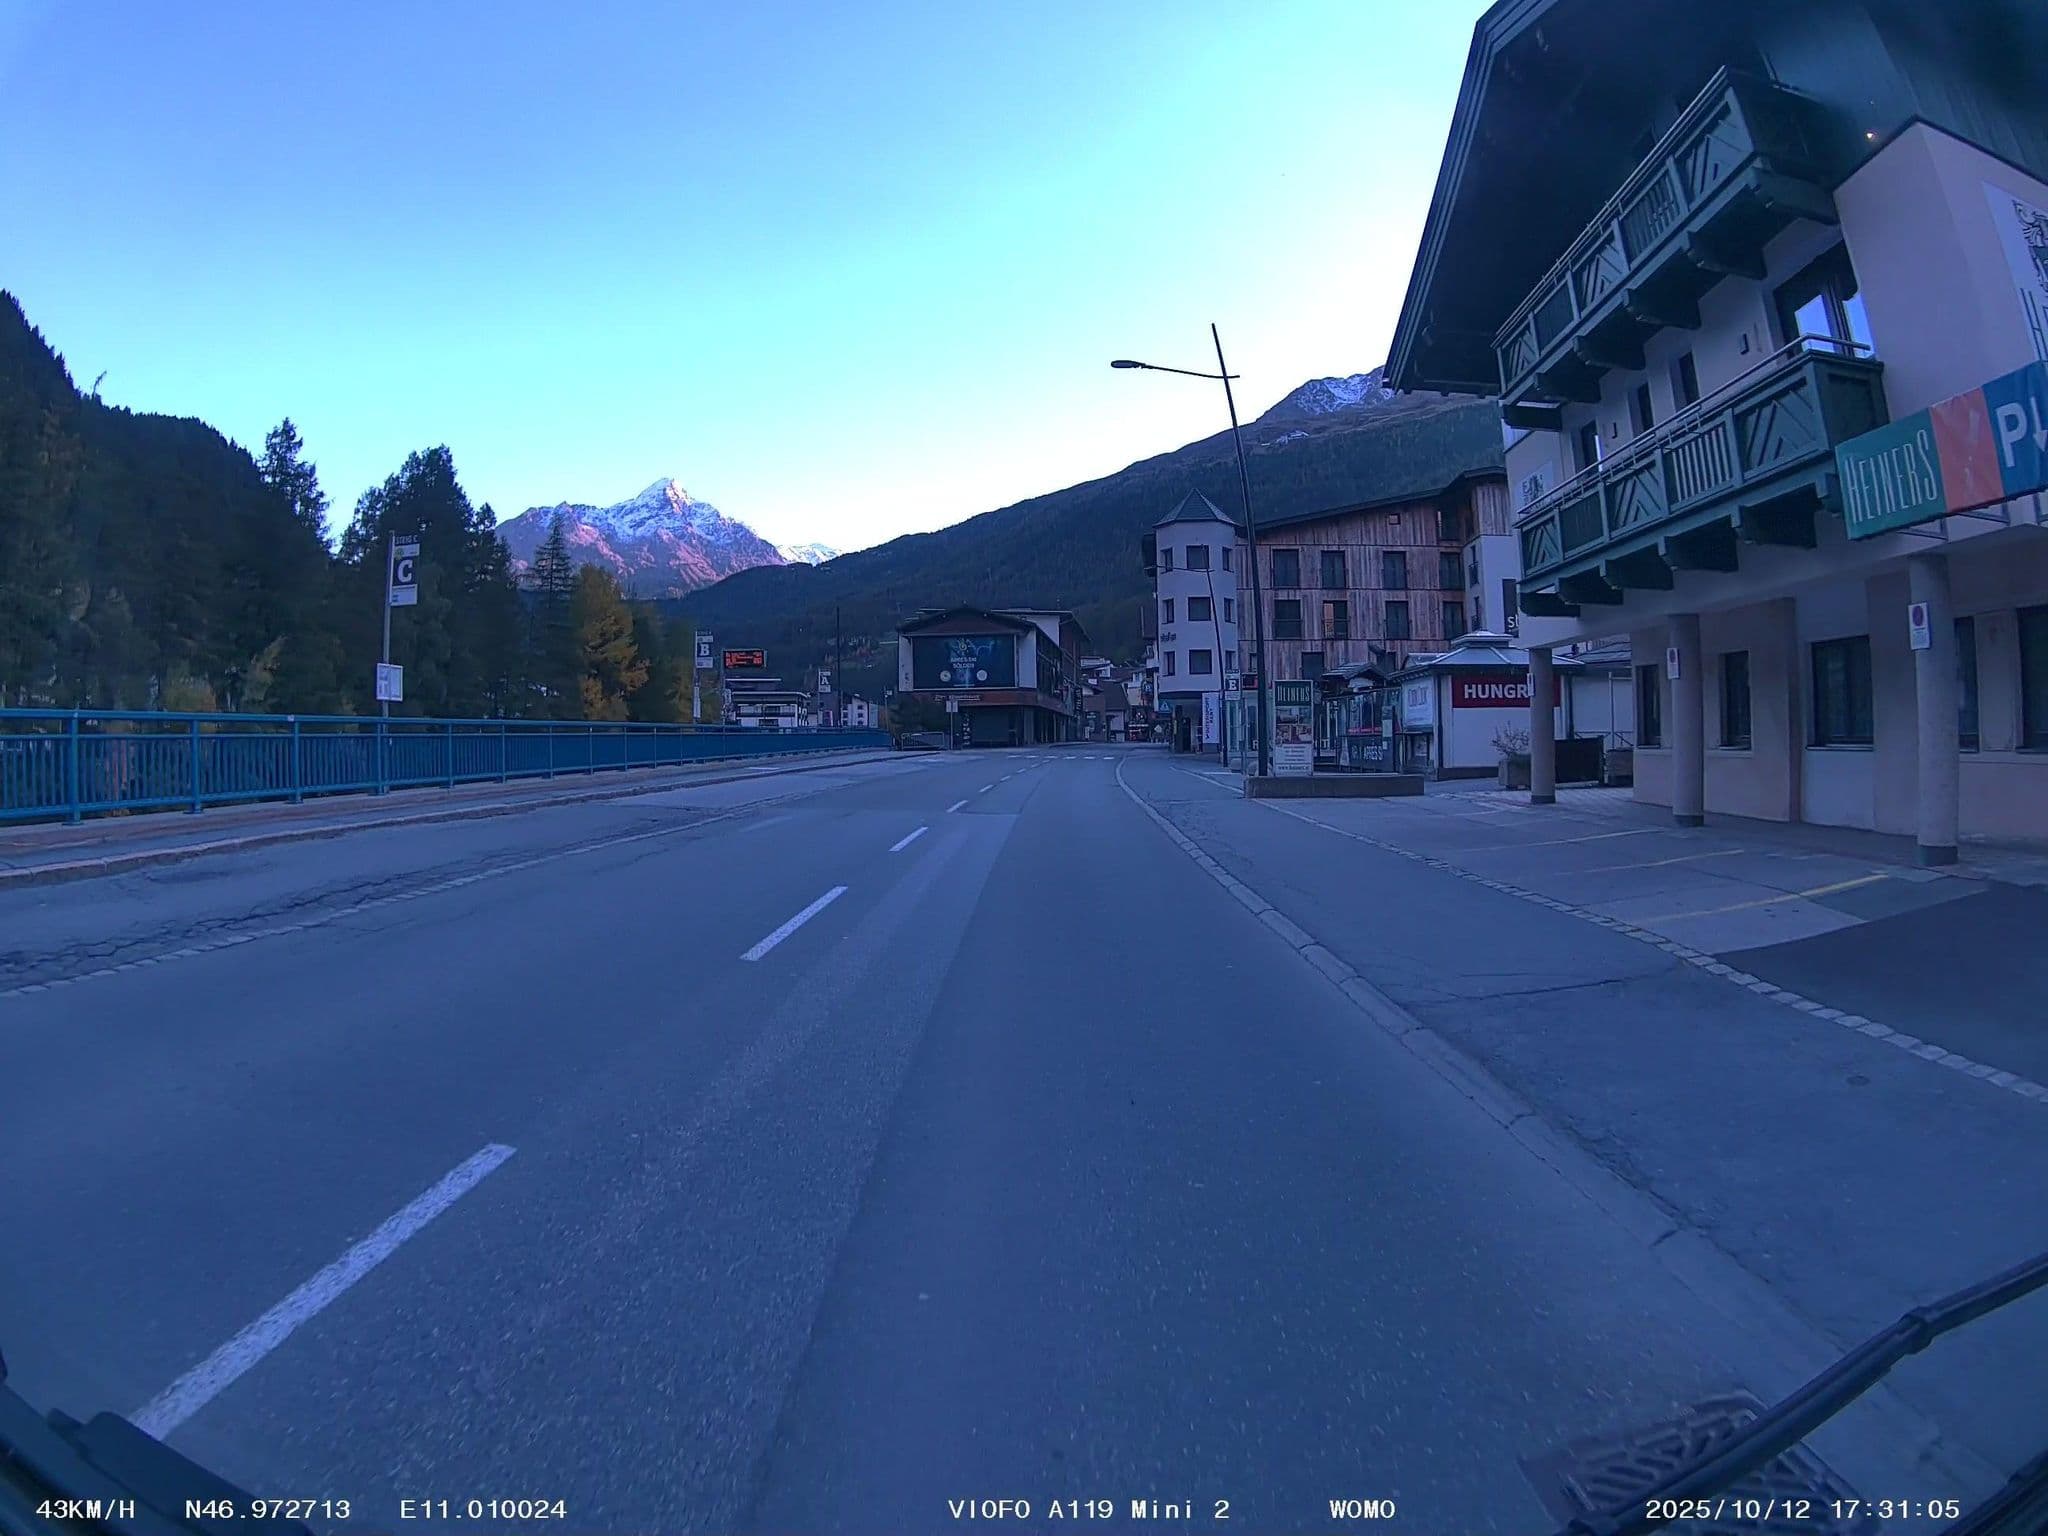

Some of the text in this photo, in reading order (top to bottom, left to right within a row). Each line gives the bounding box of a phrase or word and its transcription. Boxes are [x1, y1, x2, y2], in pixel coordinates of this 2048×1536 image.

[1997, 402, 2028, 468] P
[1845, 429, 1938, 525] HEINERS
[398, 560, 413, 582] C
[699, 643, 710, 656] B
[821, 676, 829, 685] A
[1228, 679, 1237, 691] E
